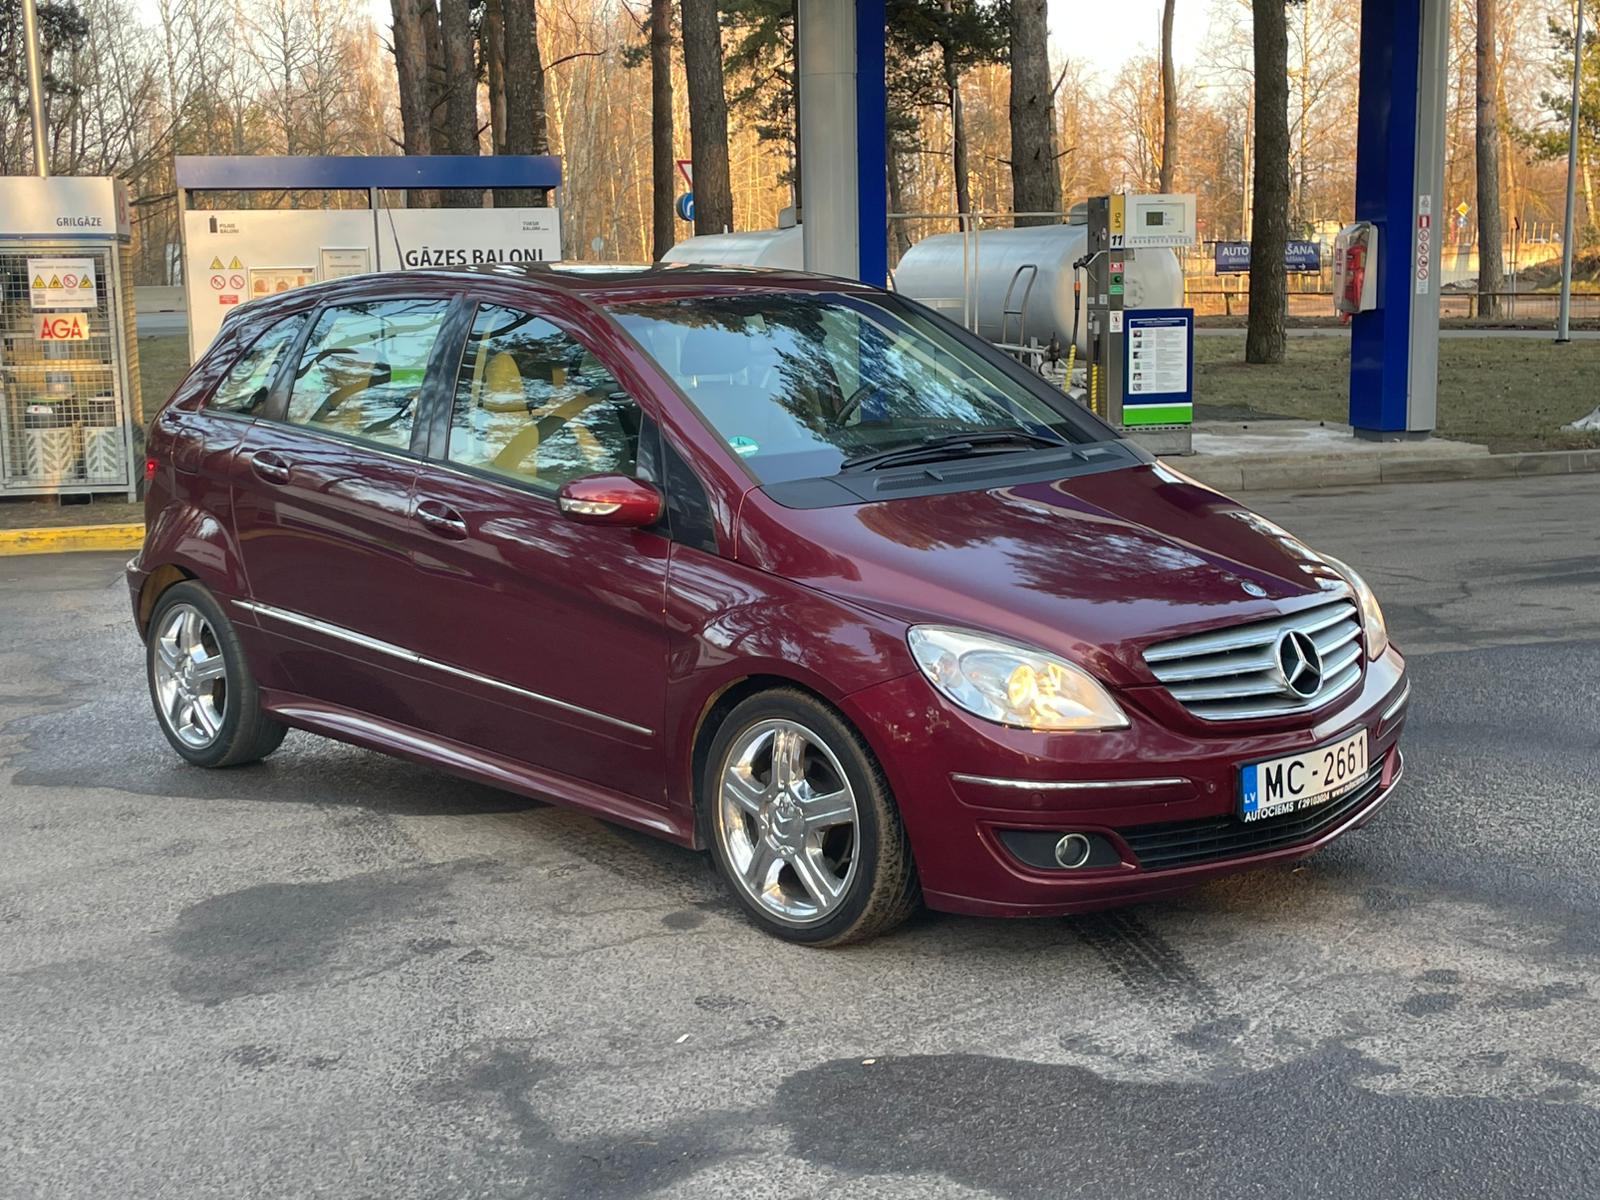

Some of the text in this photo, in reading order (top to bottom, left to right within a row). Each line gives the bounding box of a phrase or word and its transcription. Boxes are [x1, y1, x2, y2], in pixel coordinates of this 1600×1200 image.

[56, 216, 103, 227] GRILGĀZE
[1111, 235, 1123, 246] 11
[405, 246, 467, 267] GĀZES
[1222, 247, 1250, 256] AUTO
[40, 316, 83, 339] AGA
[1244, 791, 1256, 804] LV
